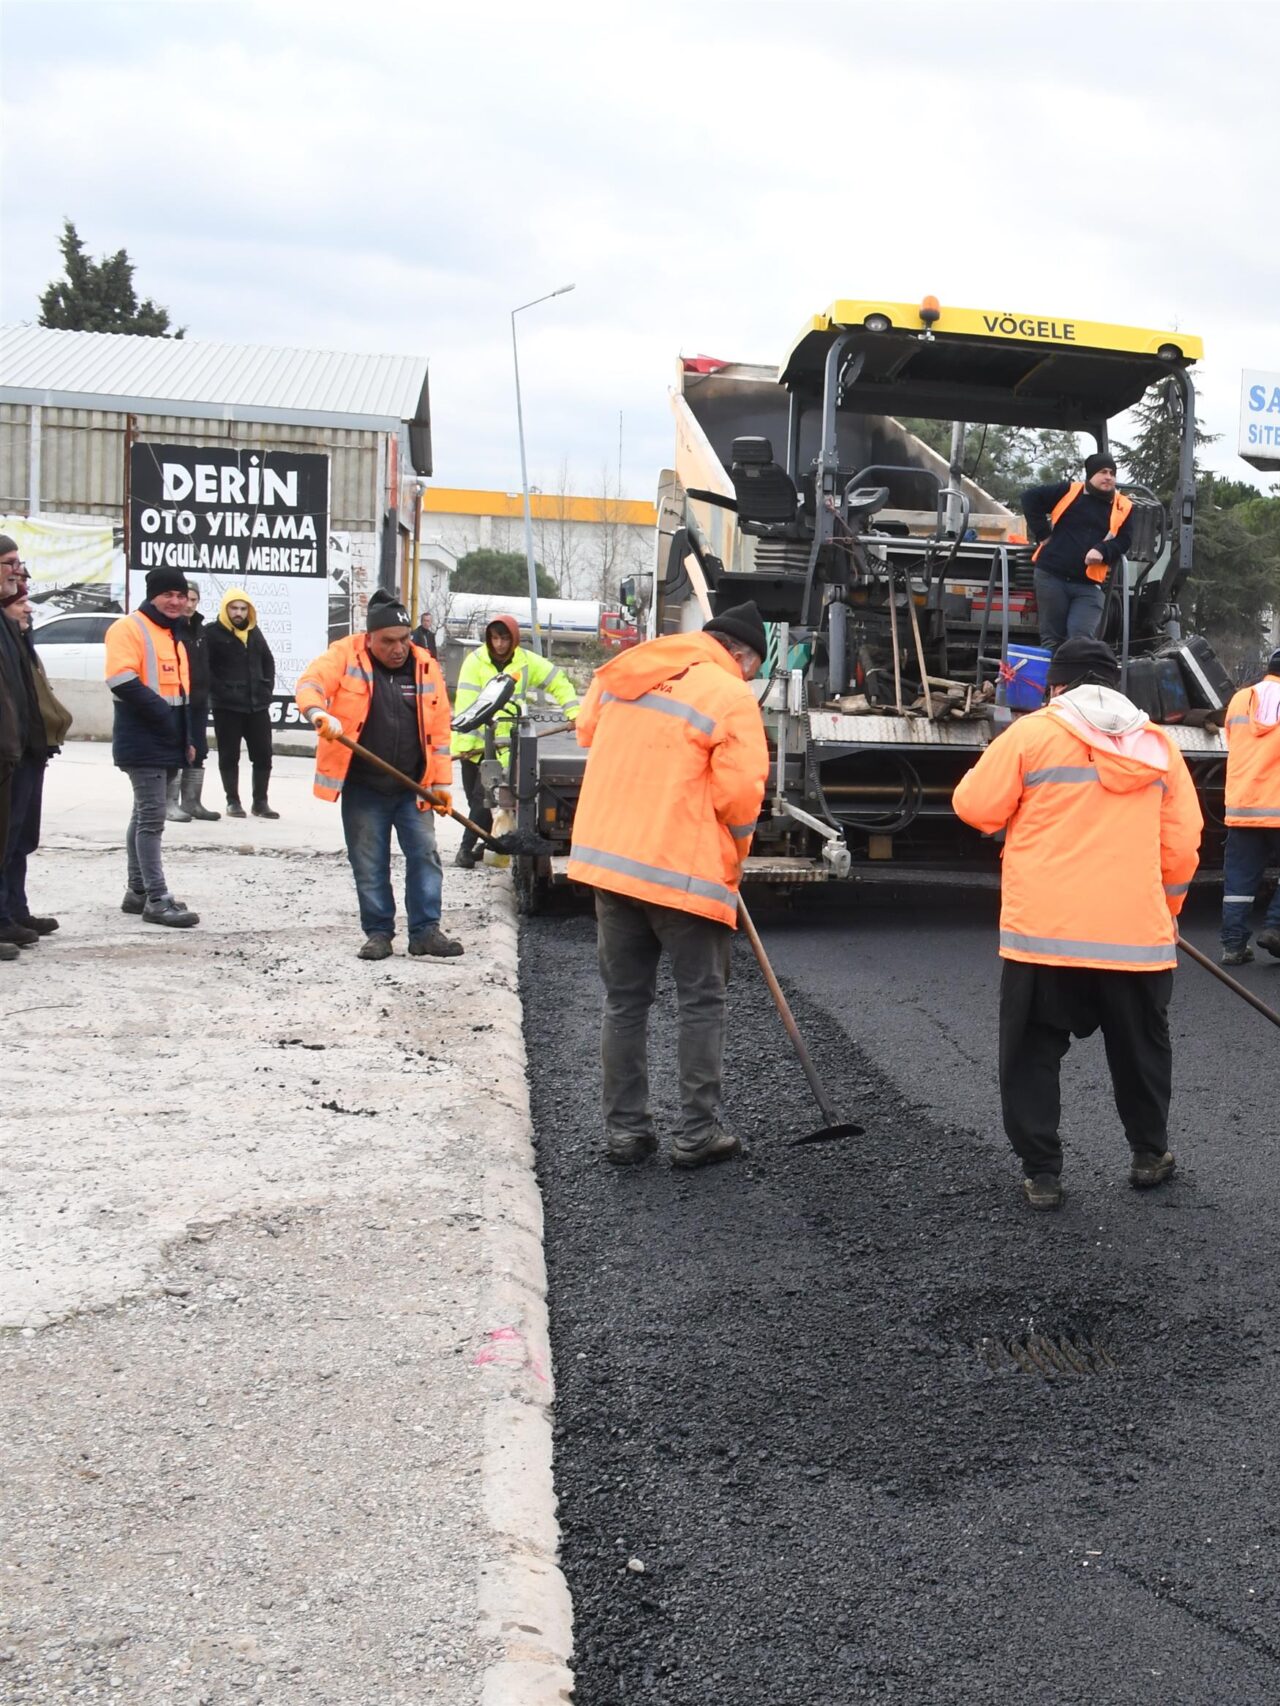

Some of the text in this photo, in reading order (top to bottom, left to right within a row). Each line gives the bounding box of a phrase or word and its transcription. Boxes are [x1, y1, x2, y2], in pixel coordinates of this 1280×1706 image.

[983, 312, 1076, 341] VÖGELE
[162, 454, 298, 507] DERİN
[140, 507, 318, 541] OTO YIKAMA
[140, 541, 240, 570] UYGULAMA
[246, 542, 318, 574] MERKEZİ
